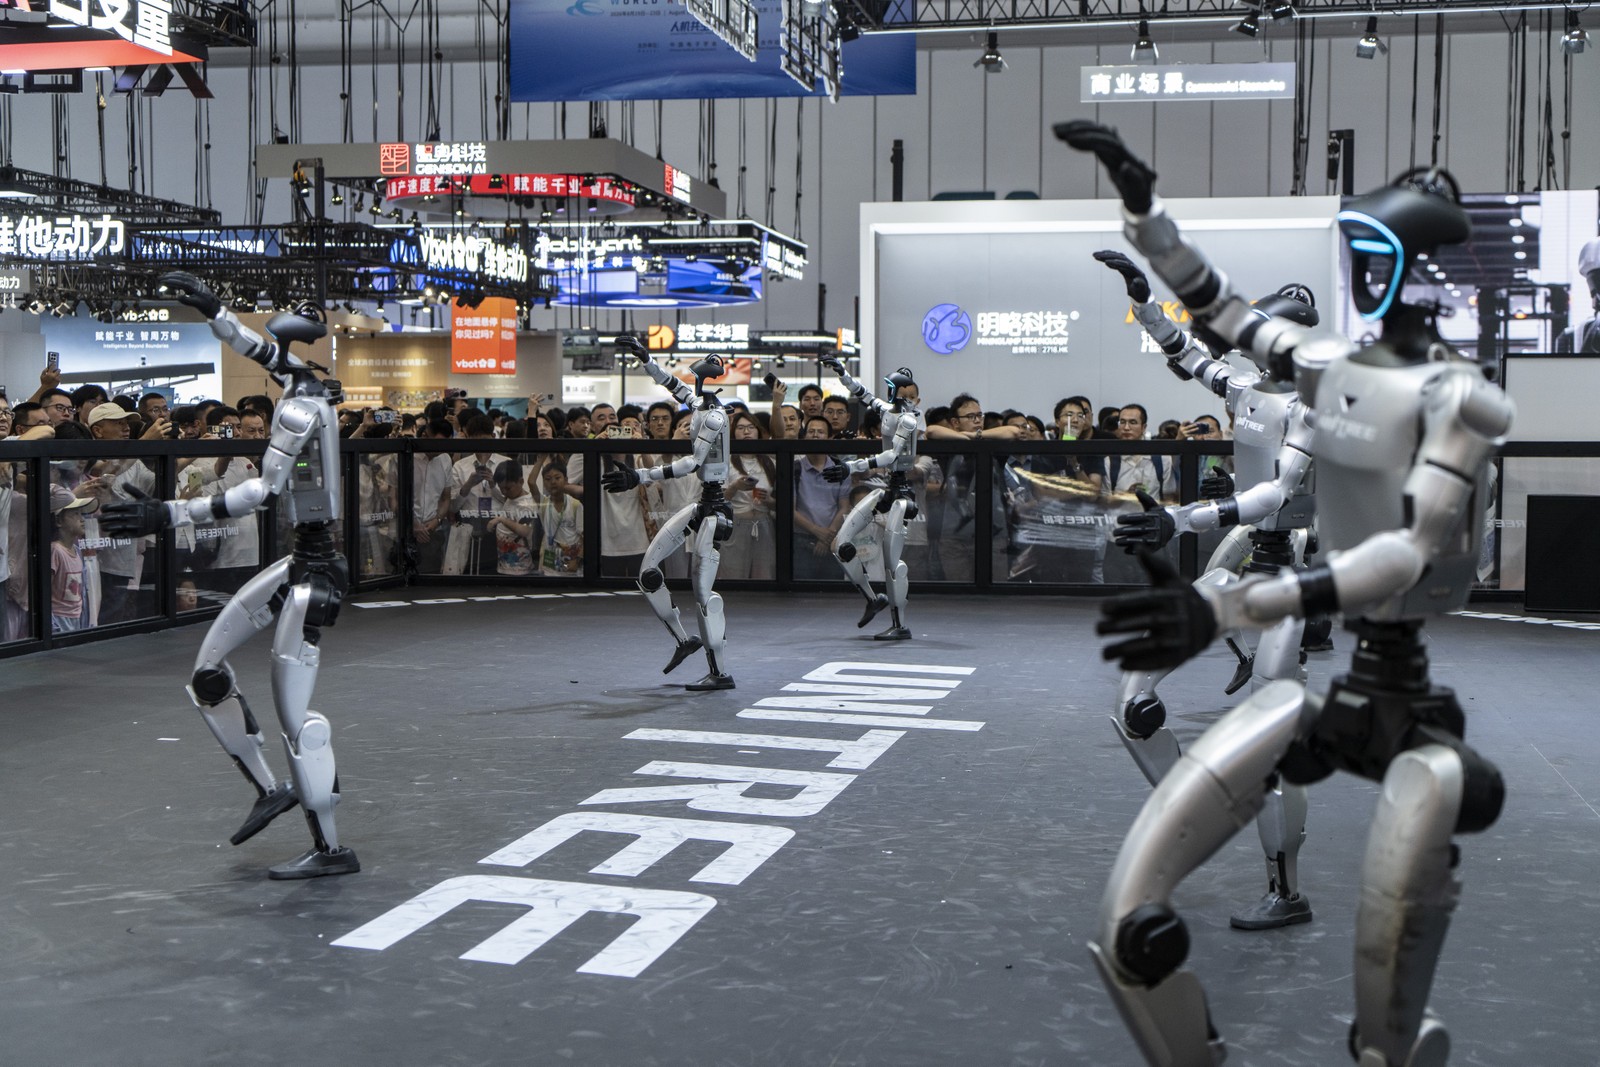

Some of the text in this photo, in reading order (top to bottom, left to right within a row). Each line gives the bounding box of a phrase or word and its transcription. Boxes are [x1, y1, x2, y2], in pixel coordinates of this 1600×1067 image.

[1091, 72, 1184, 94] 商业场景
[473, 163, 486, 174] AI
[513, 176, 581, 194] 赋能千业
[95, 331, 135, 341] 赋能千业
[678, 323, 749, 342] 数字华夏
[329, 661, 987, 978] UNITREE
